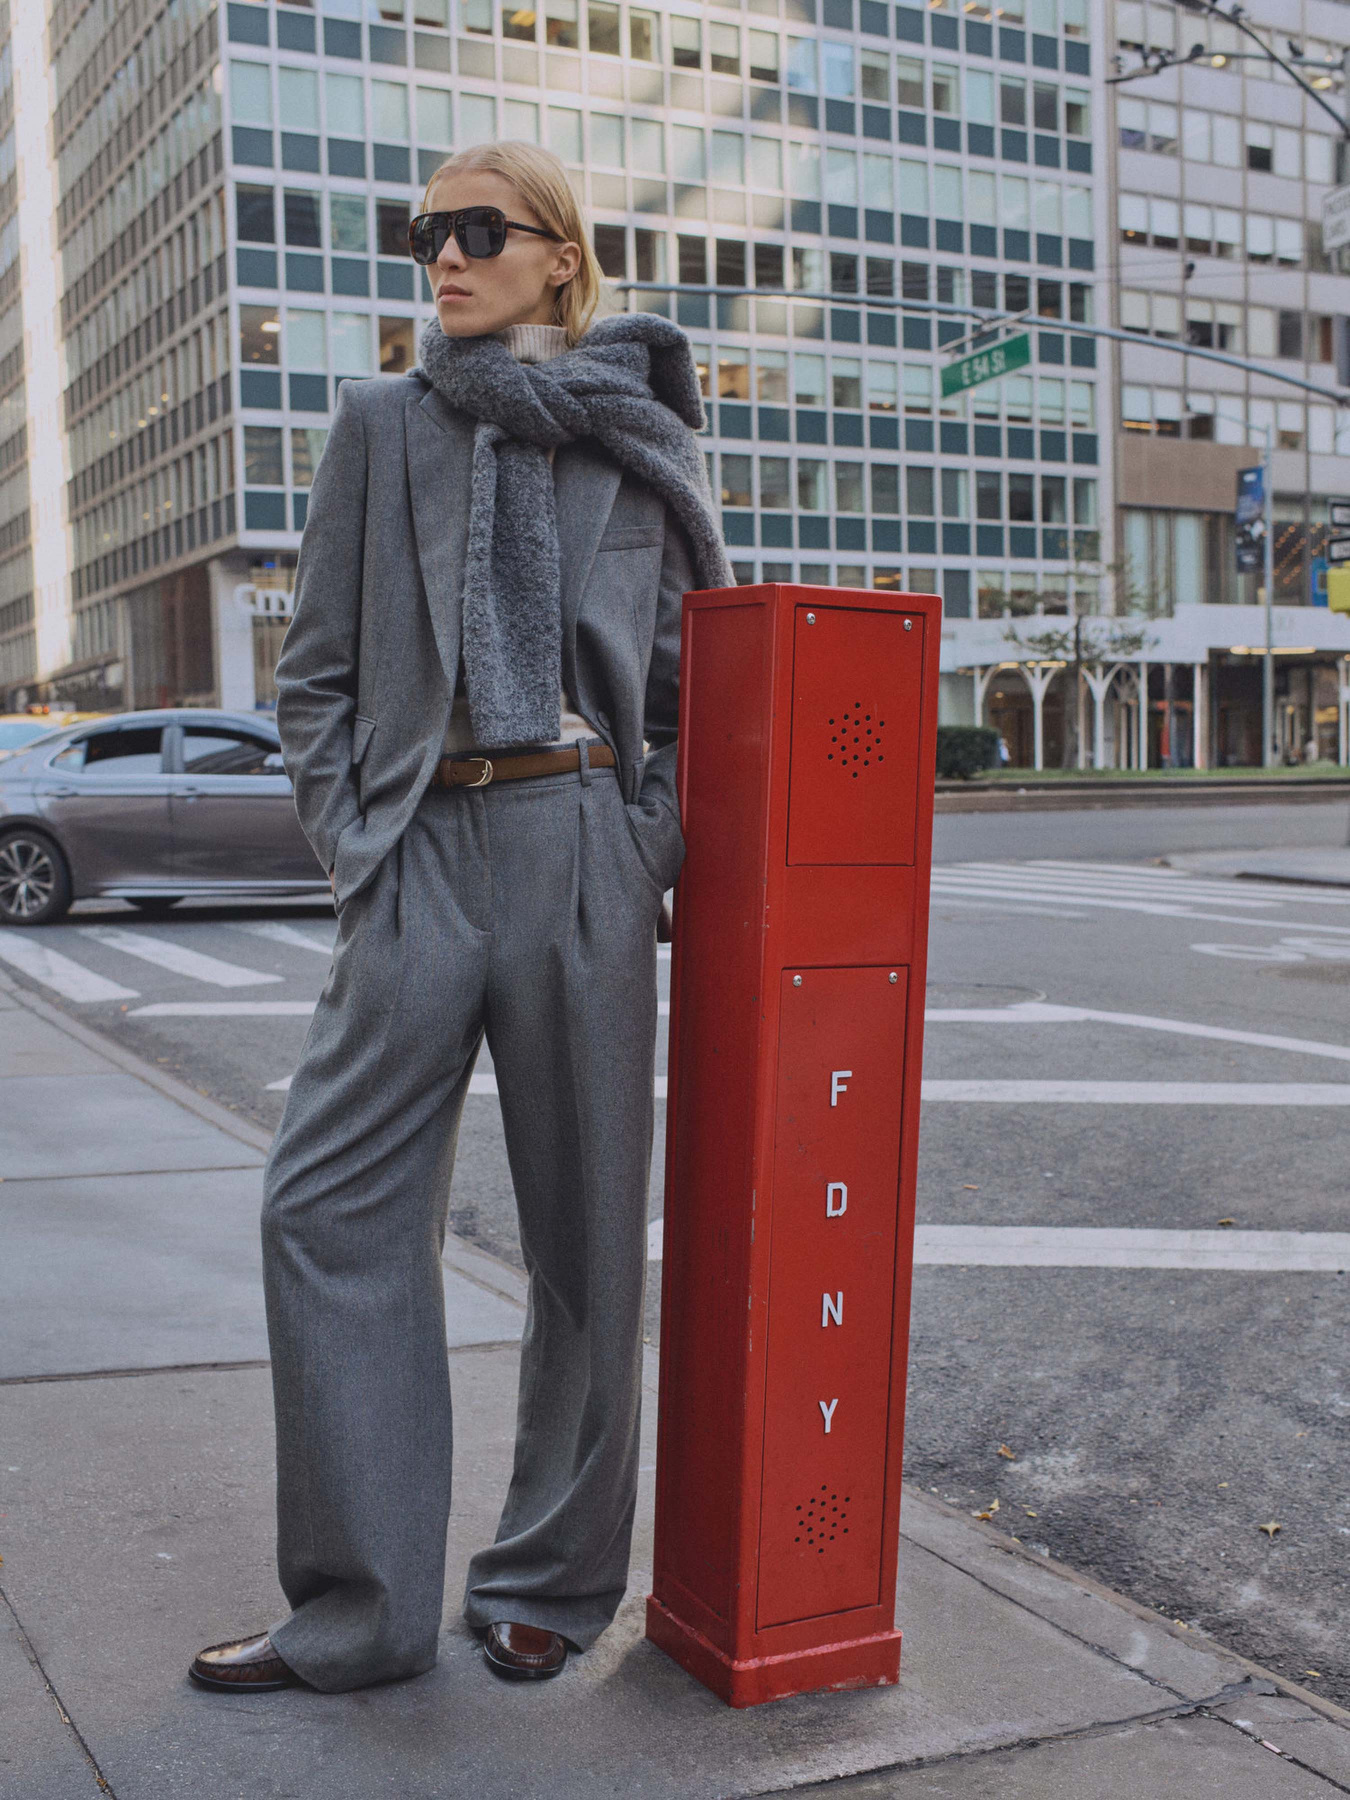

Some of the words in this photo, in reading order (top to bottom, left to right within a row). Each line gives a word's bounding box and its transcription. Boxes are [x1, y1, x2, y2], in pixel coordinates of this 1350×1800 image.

[961, 361, 971, 385] E
[972, 352, 990, 381] 54
[818, 1070, 852, 1434] FDNY
